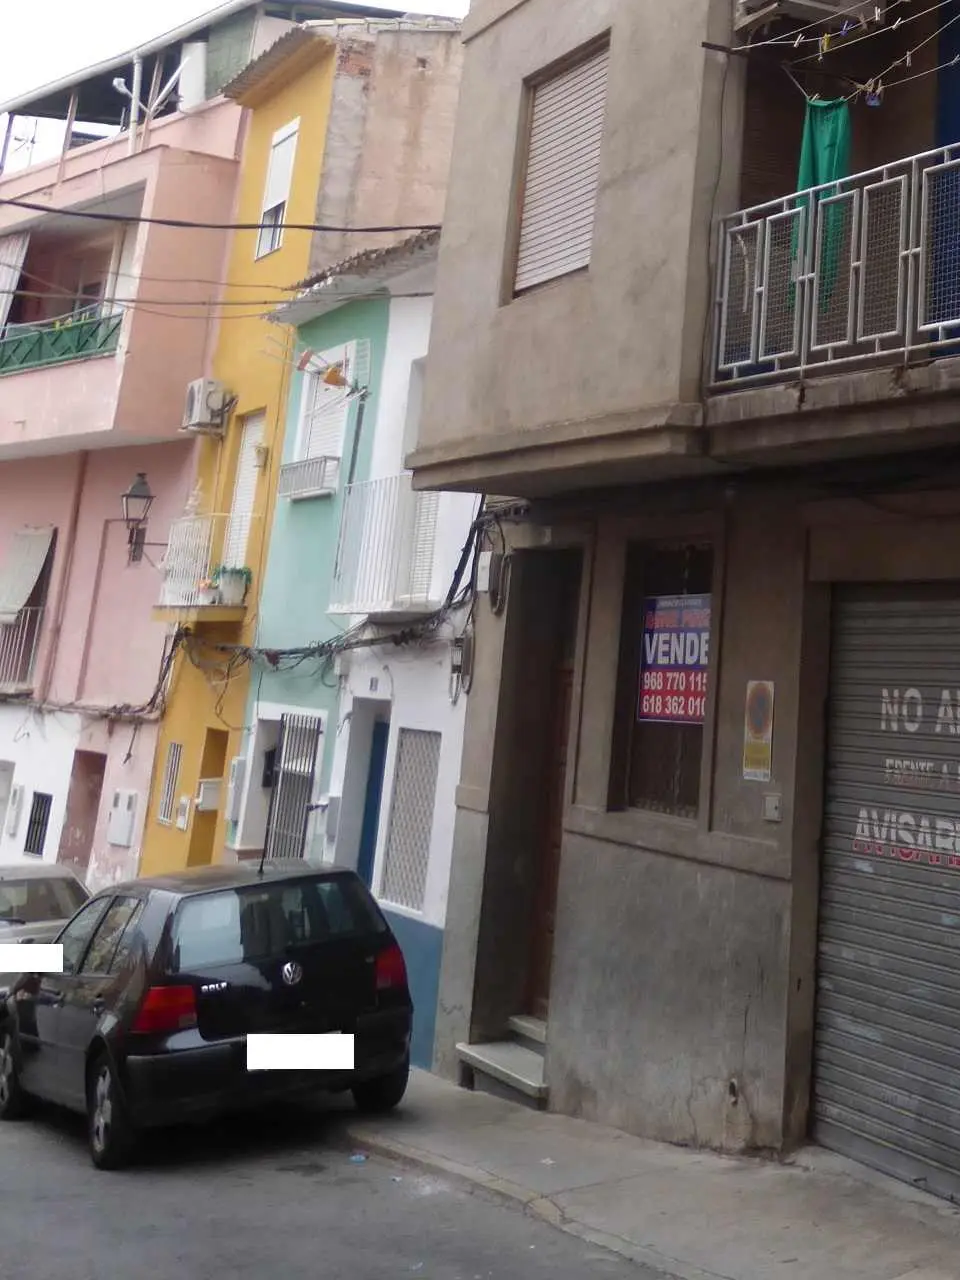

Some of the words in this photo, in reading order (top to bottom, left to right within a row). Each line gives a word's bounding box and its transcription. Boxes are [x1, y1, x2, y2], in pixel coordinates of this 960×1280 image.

[644, 632, 708, 665] VENDE
[643, 672, 663, 690] 968
[666, 672, 685, 691] 770
[643, 694, 662, 713] 618
[665, 696, 685, 715] 362
[880, 687, 922, 733] NO
[884, 758, 934, 785] FRENTE
[939, 760, 949, 786] A
